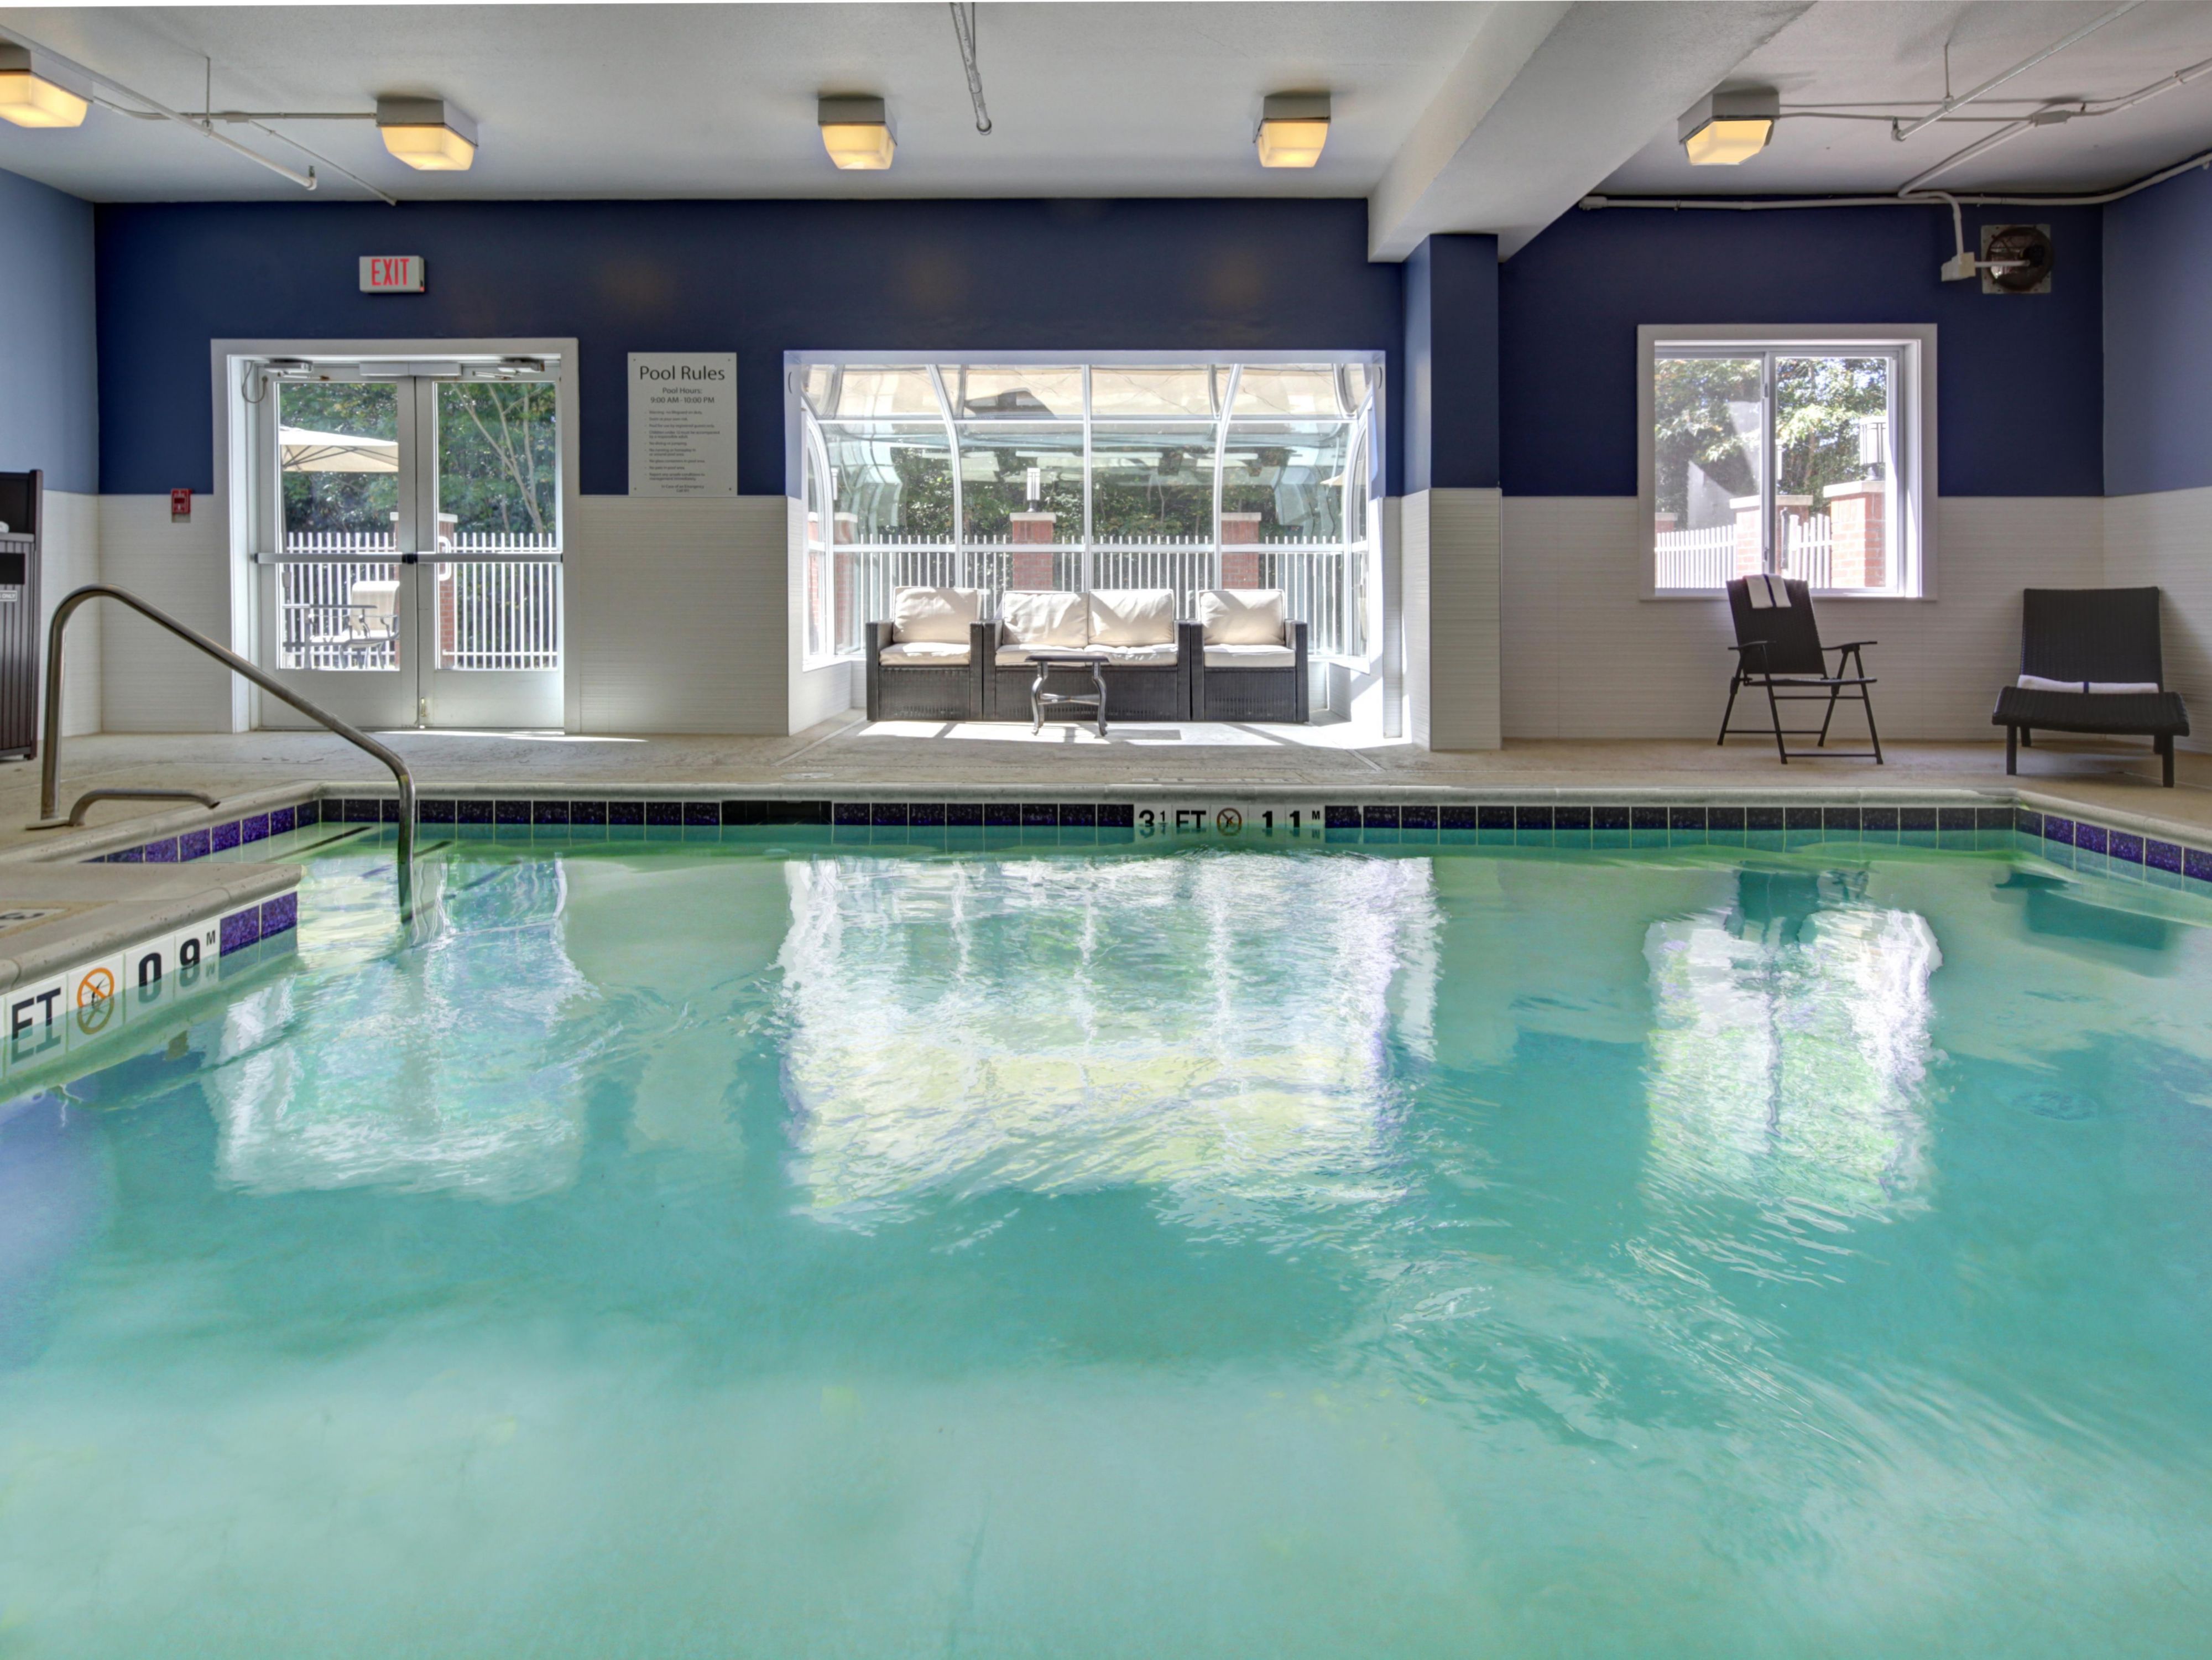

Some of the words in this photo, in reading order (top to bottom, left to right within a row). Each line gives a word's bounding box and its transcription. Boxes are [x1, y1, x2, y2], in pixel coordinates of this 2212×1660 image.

[371, 258, 410, 285] EXIT
[640, 365, 675, 381] Pool
[681, 365, 725, 381] Rules
[1176, 810, 1207, 829] FT
[12, 987, 61, 1040] FT
